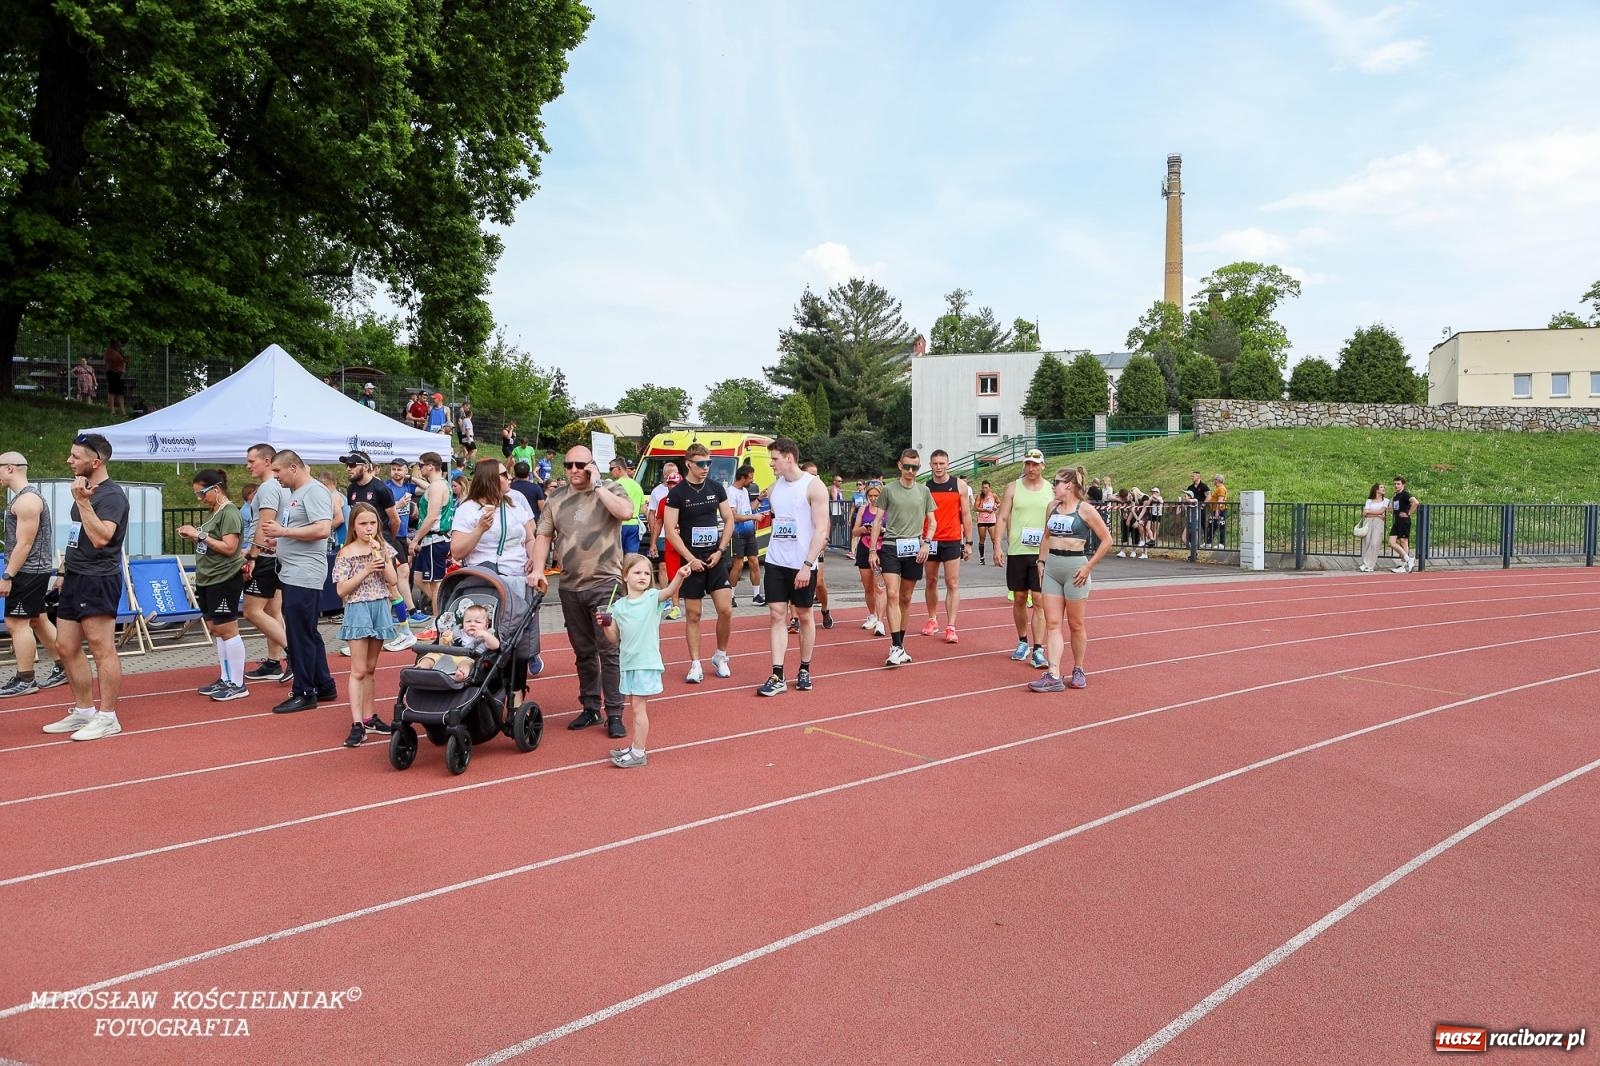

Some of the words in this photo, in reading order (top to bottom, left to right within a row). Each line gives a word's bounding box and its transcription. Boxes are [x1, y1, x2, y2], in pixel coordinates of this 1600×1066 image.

[1053, 521, 1065, 530] 231
[778, 526, 792, 534] 204
[698, 534, 713, 542] 230
[1028, 534, 1040, 542] 213
[903, 544, 916, 552] 237
[149, 579, 167, 613] odociągi
